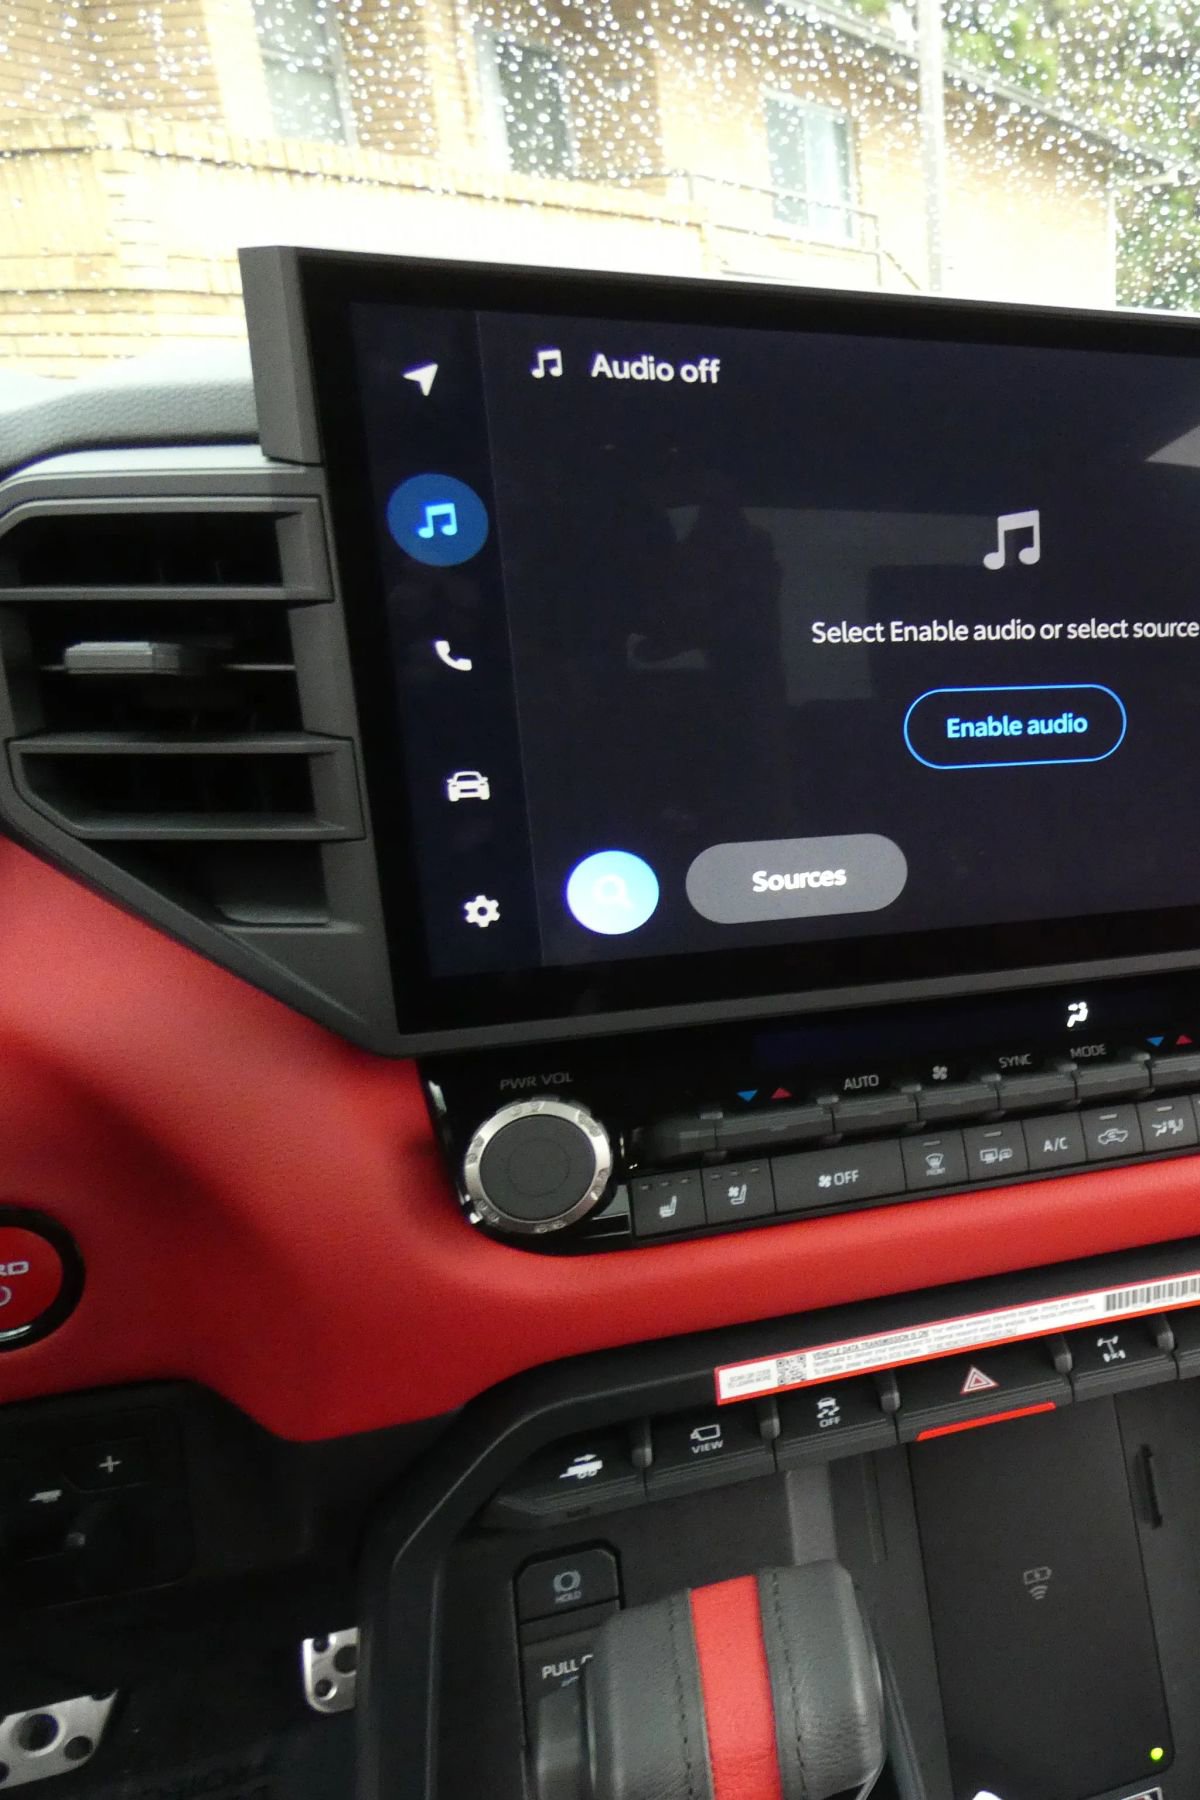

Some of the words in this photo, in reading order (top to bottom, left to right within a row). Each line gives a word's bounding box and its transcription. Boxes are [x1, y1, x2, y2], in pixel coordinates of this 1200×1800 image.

[591, 353, 675, 382] Audio
[680, 358, 720, 383] off
[811, 621, 885, 643] Select
[890, 620, 969, 642] Enable
[974, 619, 1036, 641] audio
[1039, 623, 1063, 640] or
[1066, 618, 1130, 639] select
[1133, 620, 1200, 638] source
[946, 715, 1023, 738] Enable
[1026, 713, 1088, 735] audio
[752, 869, 847, 892] Sources
[1070, 1043, 1107, 1058] MODE
[998, 1053, 1033, 1069] SYNC
[500, 1074, 537, 1091] PWR
[540, 1071, 573, 1086] VOL
[843, 1074, 880, 1091] AUTO
[1043, 1136, 1069, 1153] A/C
[833, 1169, 860, 1186] OFF
[818, 1415, 841, 1428] OFF
[691, 1439, 724, 1454] VIEW
[542, 1659, 579, 1680] PULL
